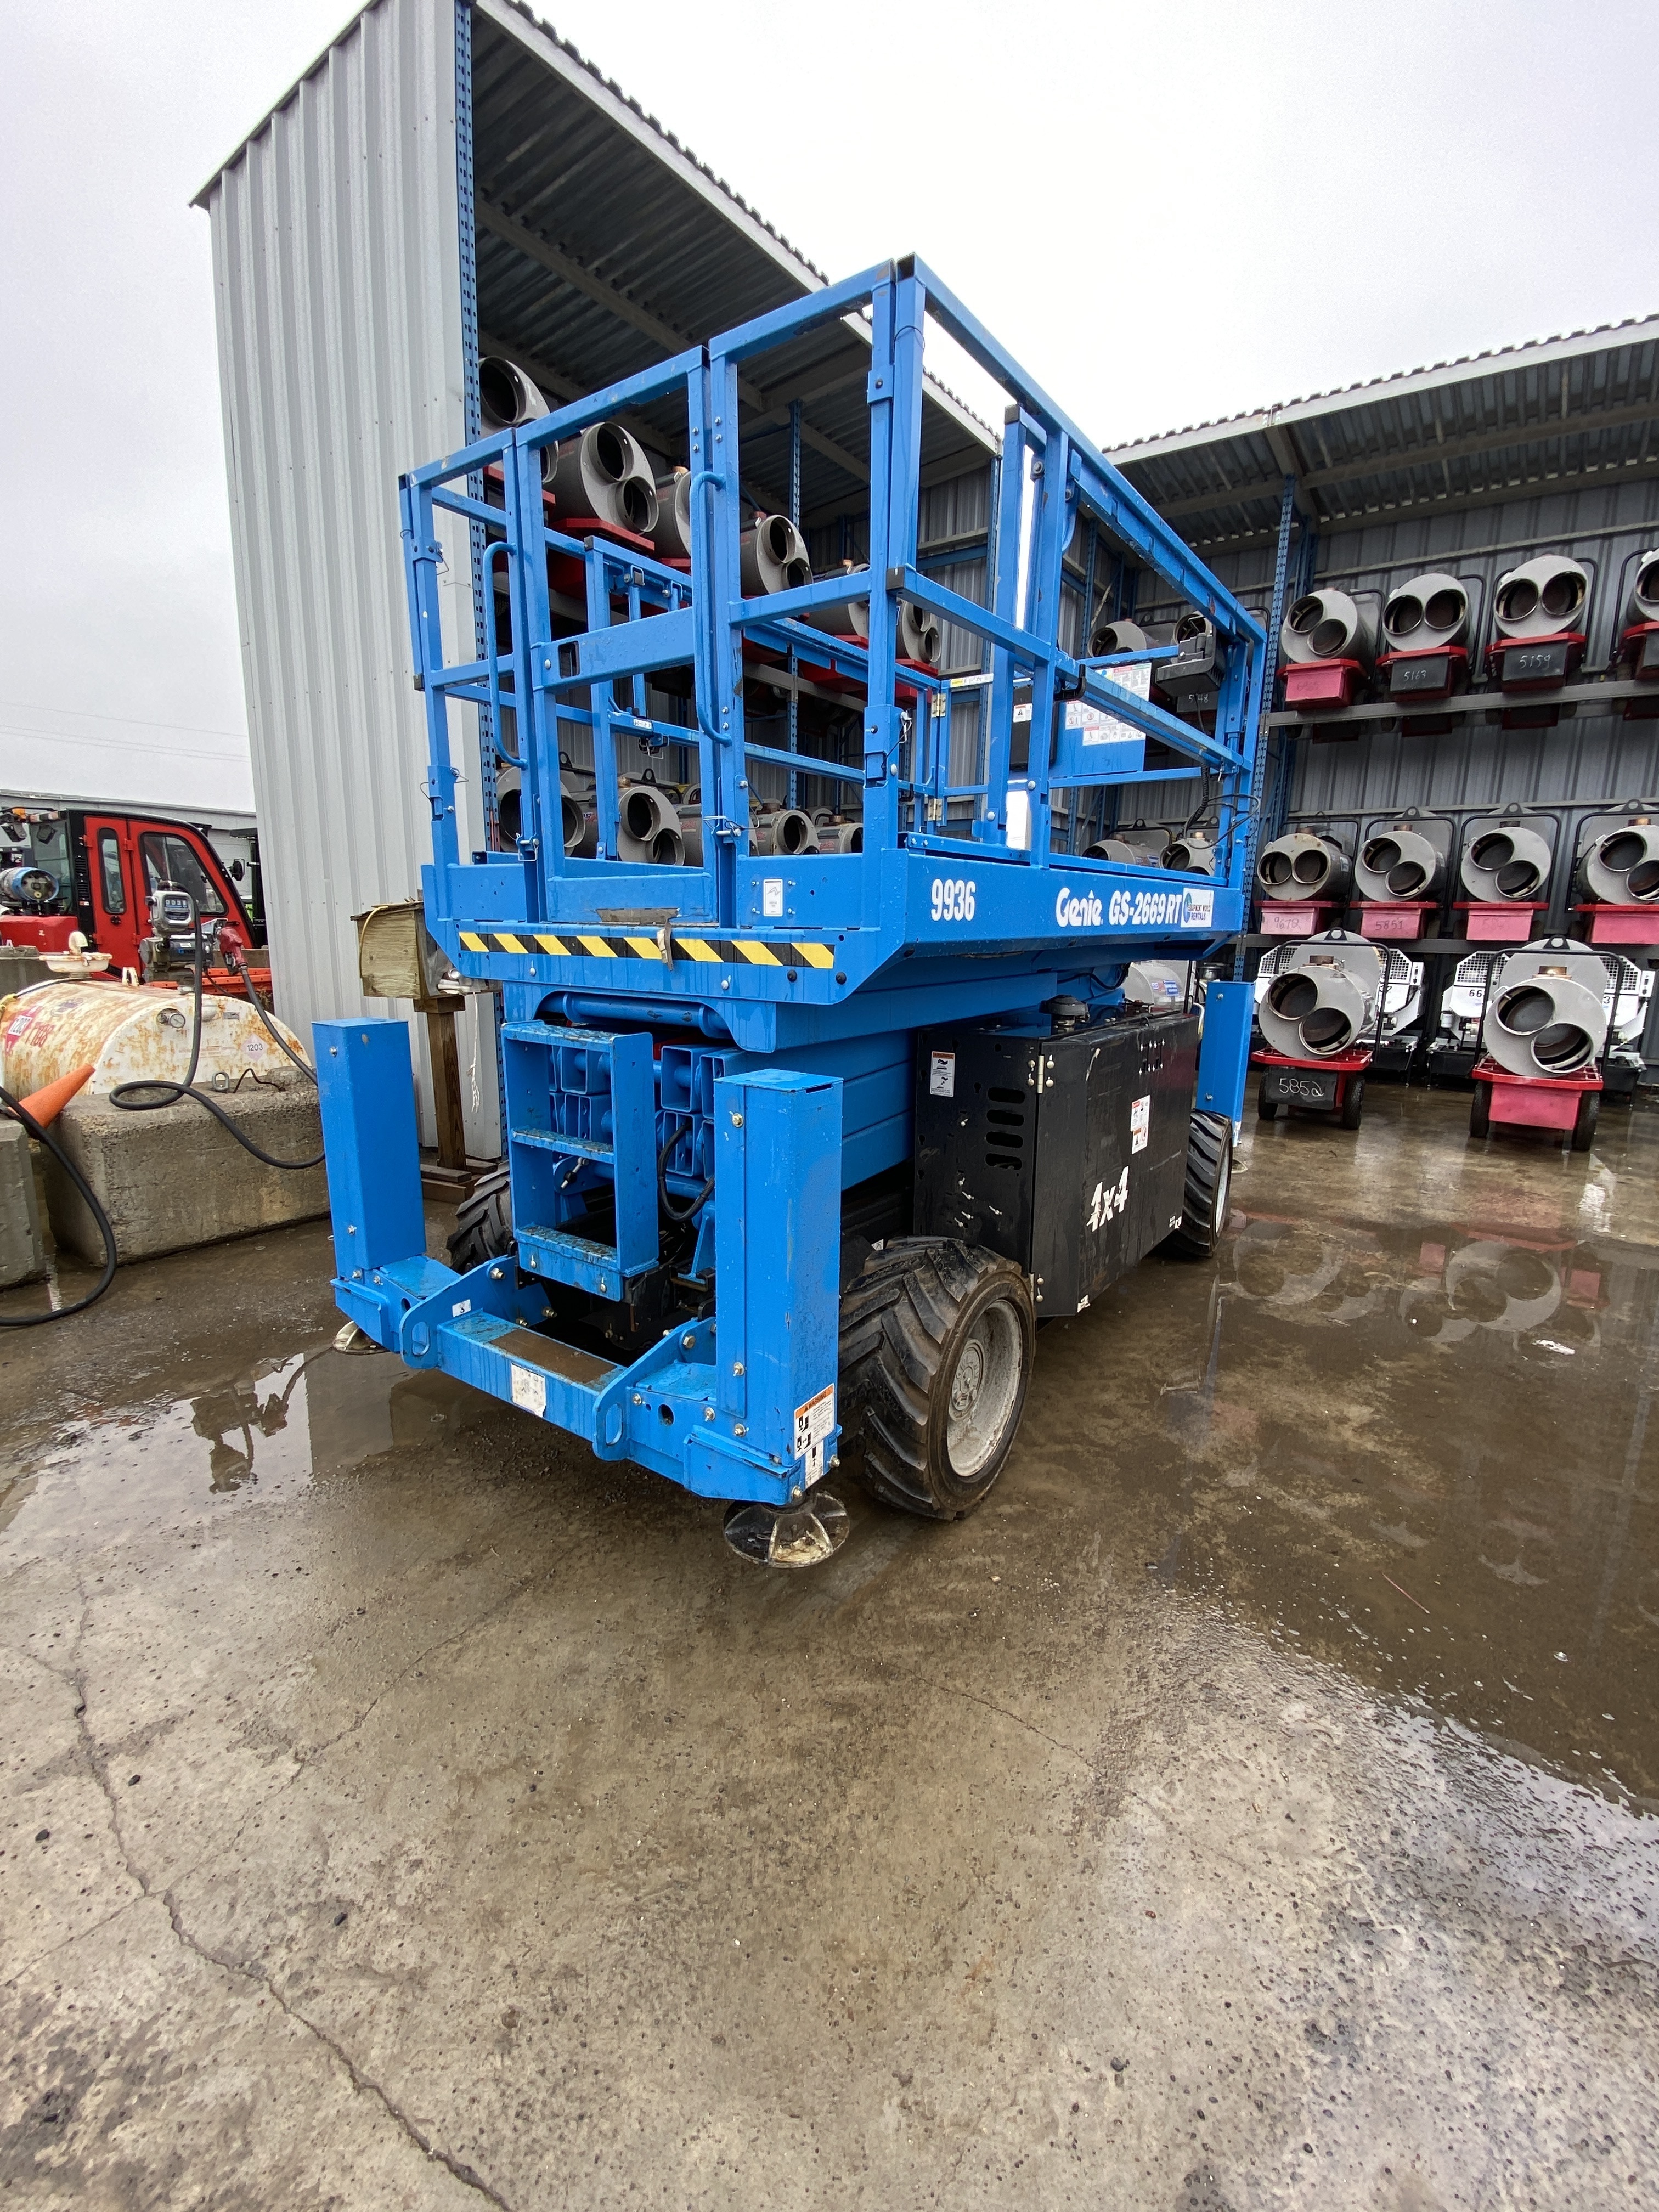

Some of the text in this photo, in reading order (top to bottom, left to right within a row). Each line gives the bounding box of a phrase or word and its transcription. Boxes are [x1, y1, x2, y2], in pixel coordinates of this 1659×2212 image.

[1520, 654, 1551, 670] 5159
[1404, 670, 1427, 681] 5163
[1189, 693, 1209, 703] 548
[931, 879, 976, 921] 9936
[1056, 887, 1102, 928] Genie
[1109, 890, 1166, 926] GS-2669
[1274, 916, 1302, 930] 9672
[1375, 920, 1403, 930] 5851
[246, 1043, 264, 1052] 1203
[1278, 1077, 1324, 1097] 5852
